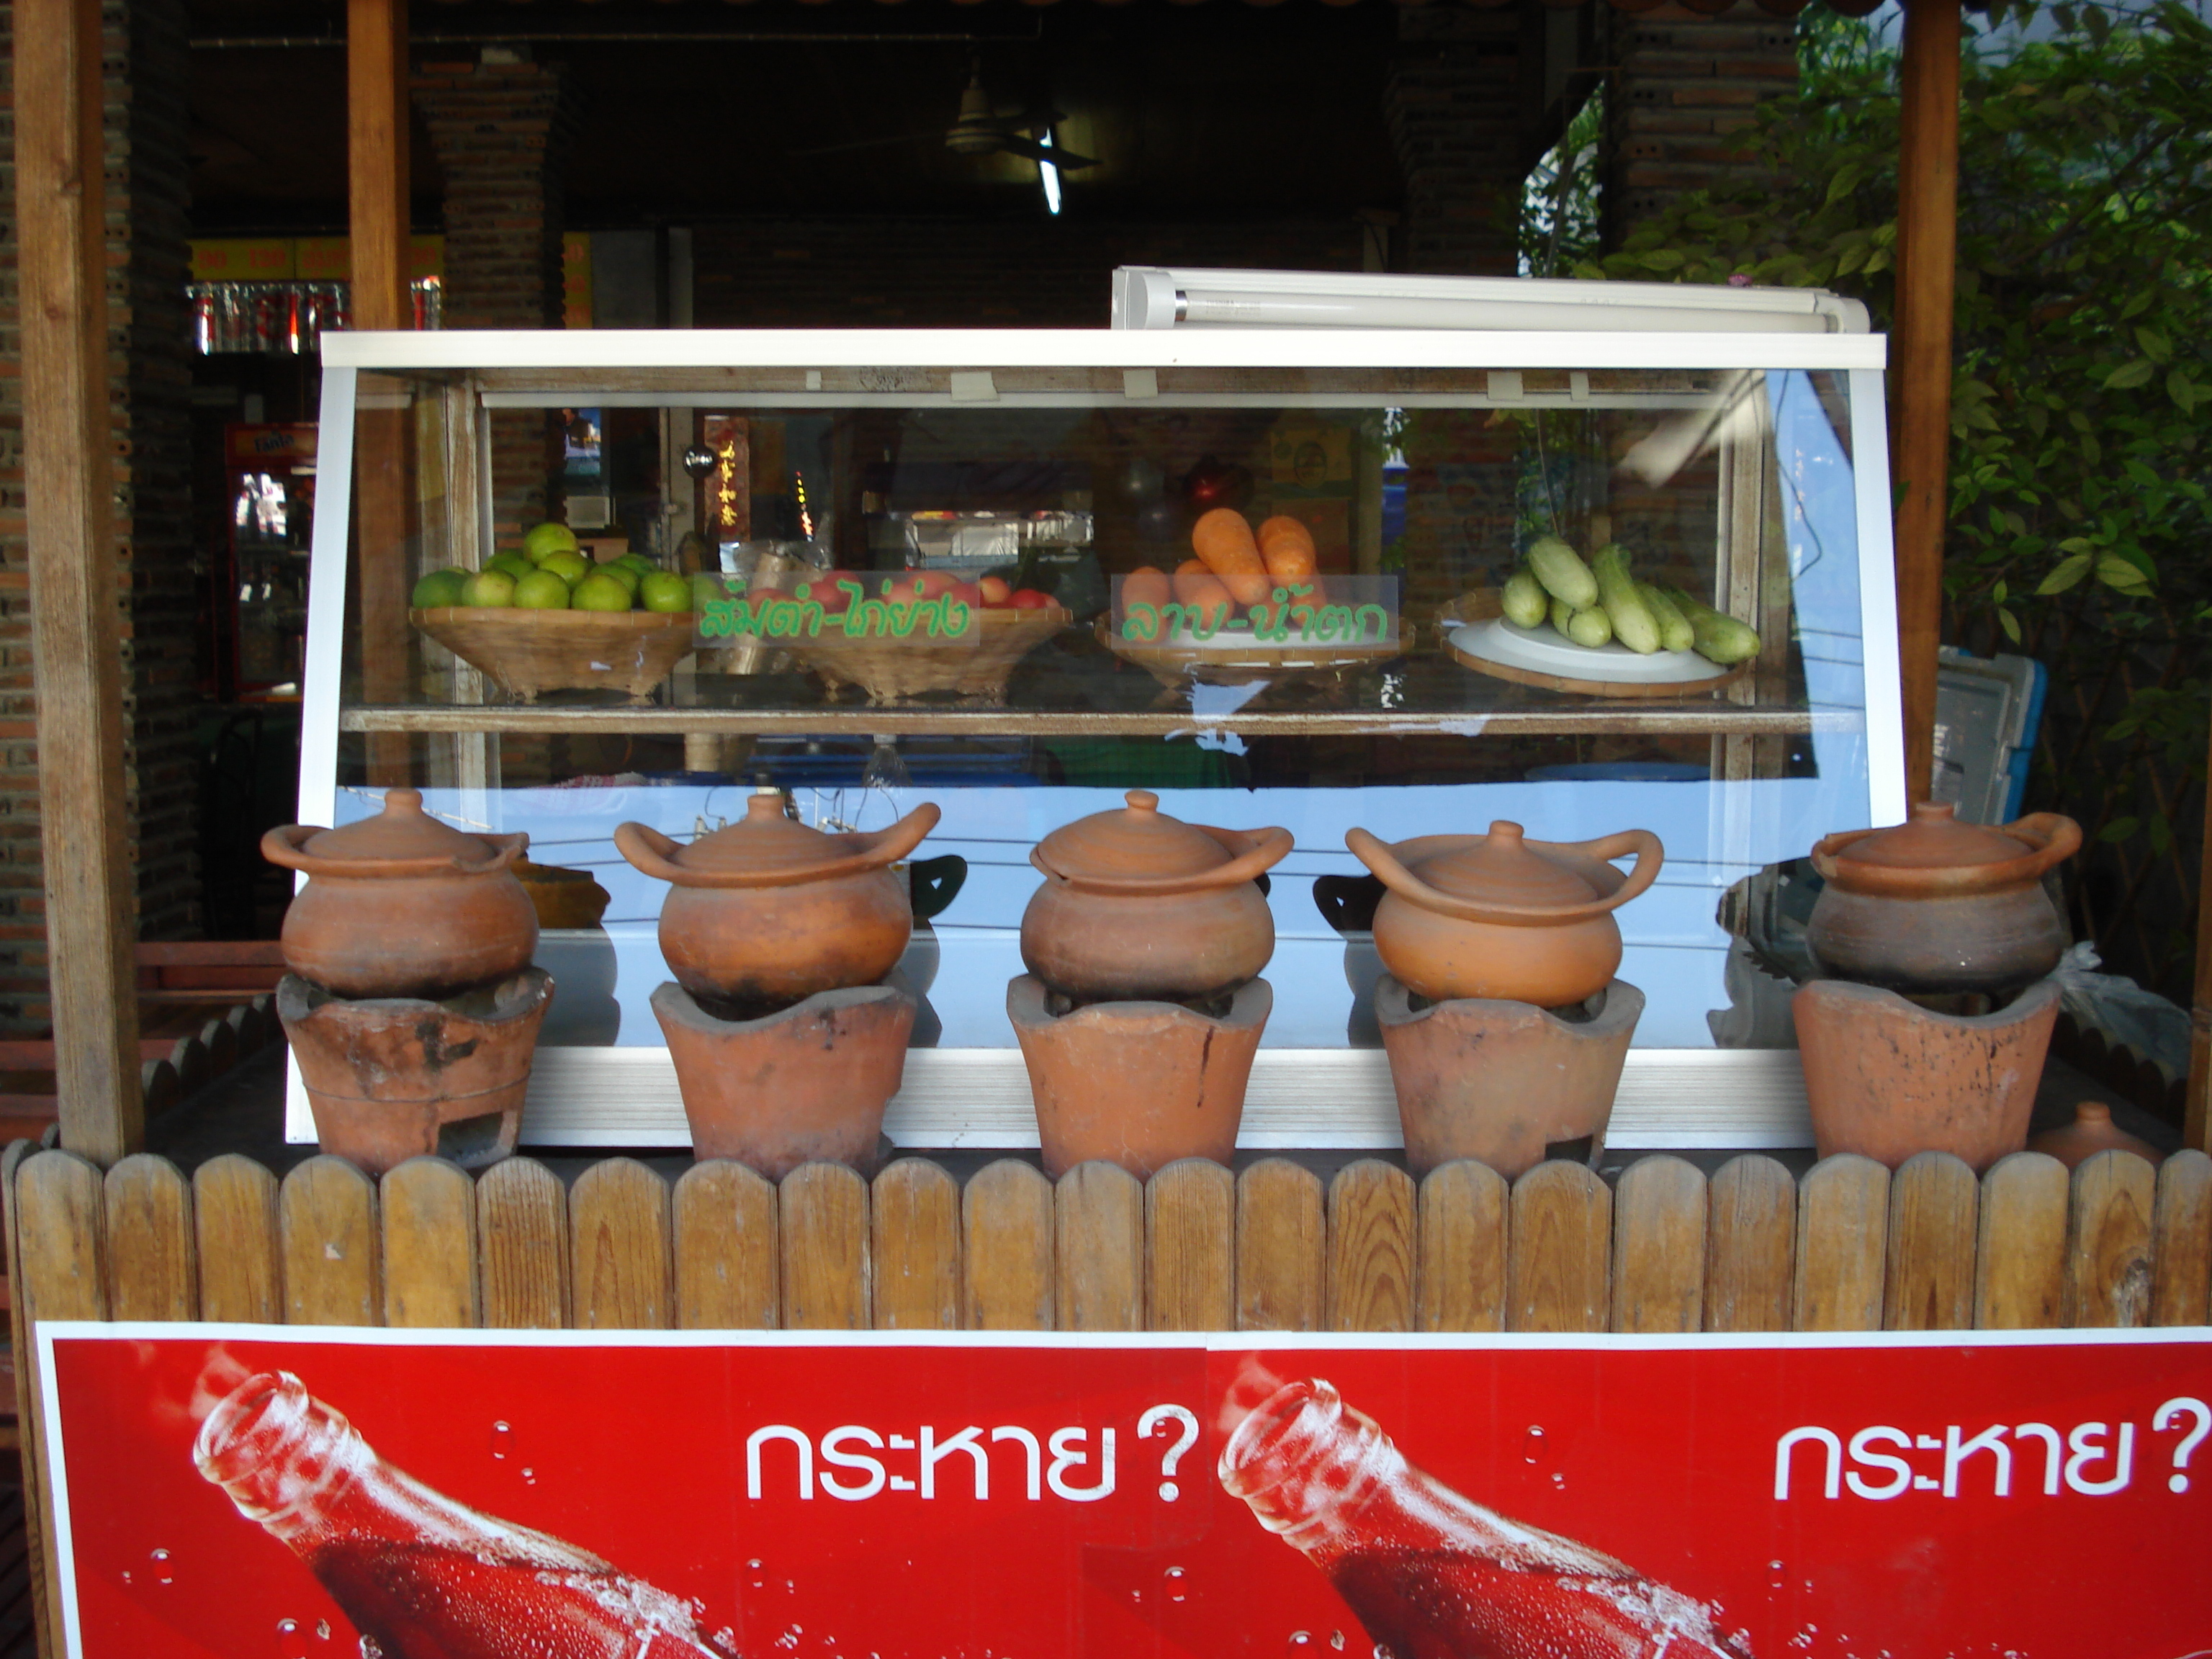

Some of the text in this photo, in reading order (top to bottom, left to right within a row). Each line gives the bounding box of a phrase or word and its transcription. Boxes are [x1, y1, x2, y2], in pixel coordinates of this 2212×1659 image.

[699, 578, 970, 639] ส้มตำ-ไก่ย่าง
[1121, 583, 1389, 643] ลาบ-น้ำตก
[746, 1403, 1200, 1503] กระหาย ?
[1773, 1396, 2212, 1501] กระหาย ?
